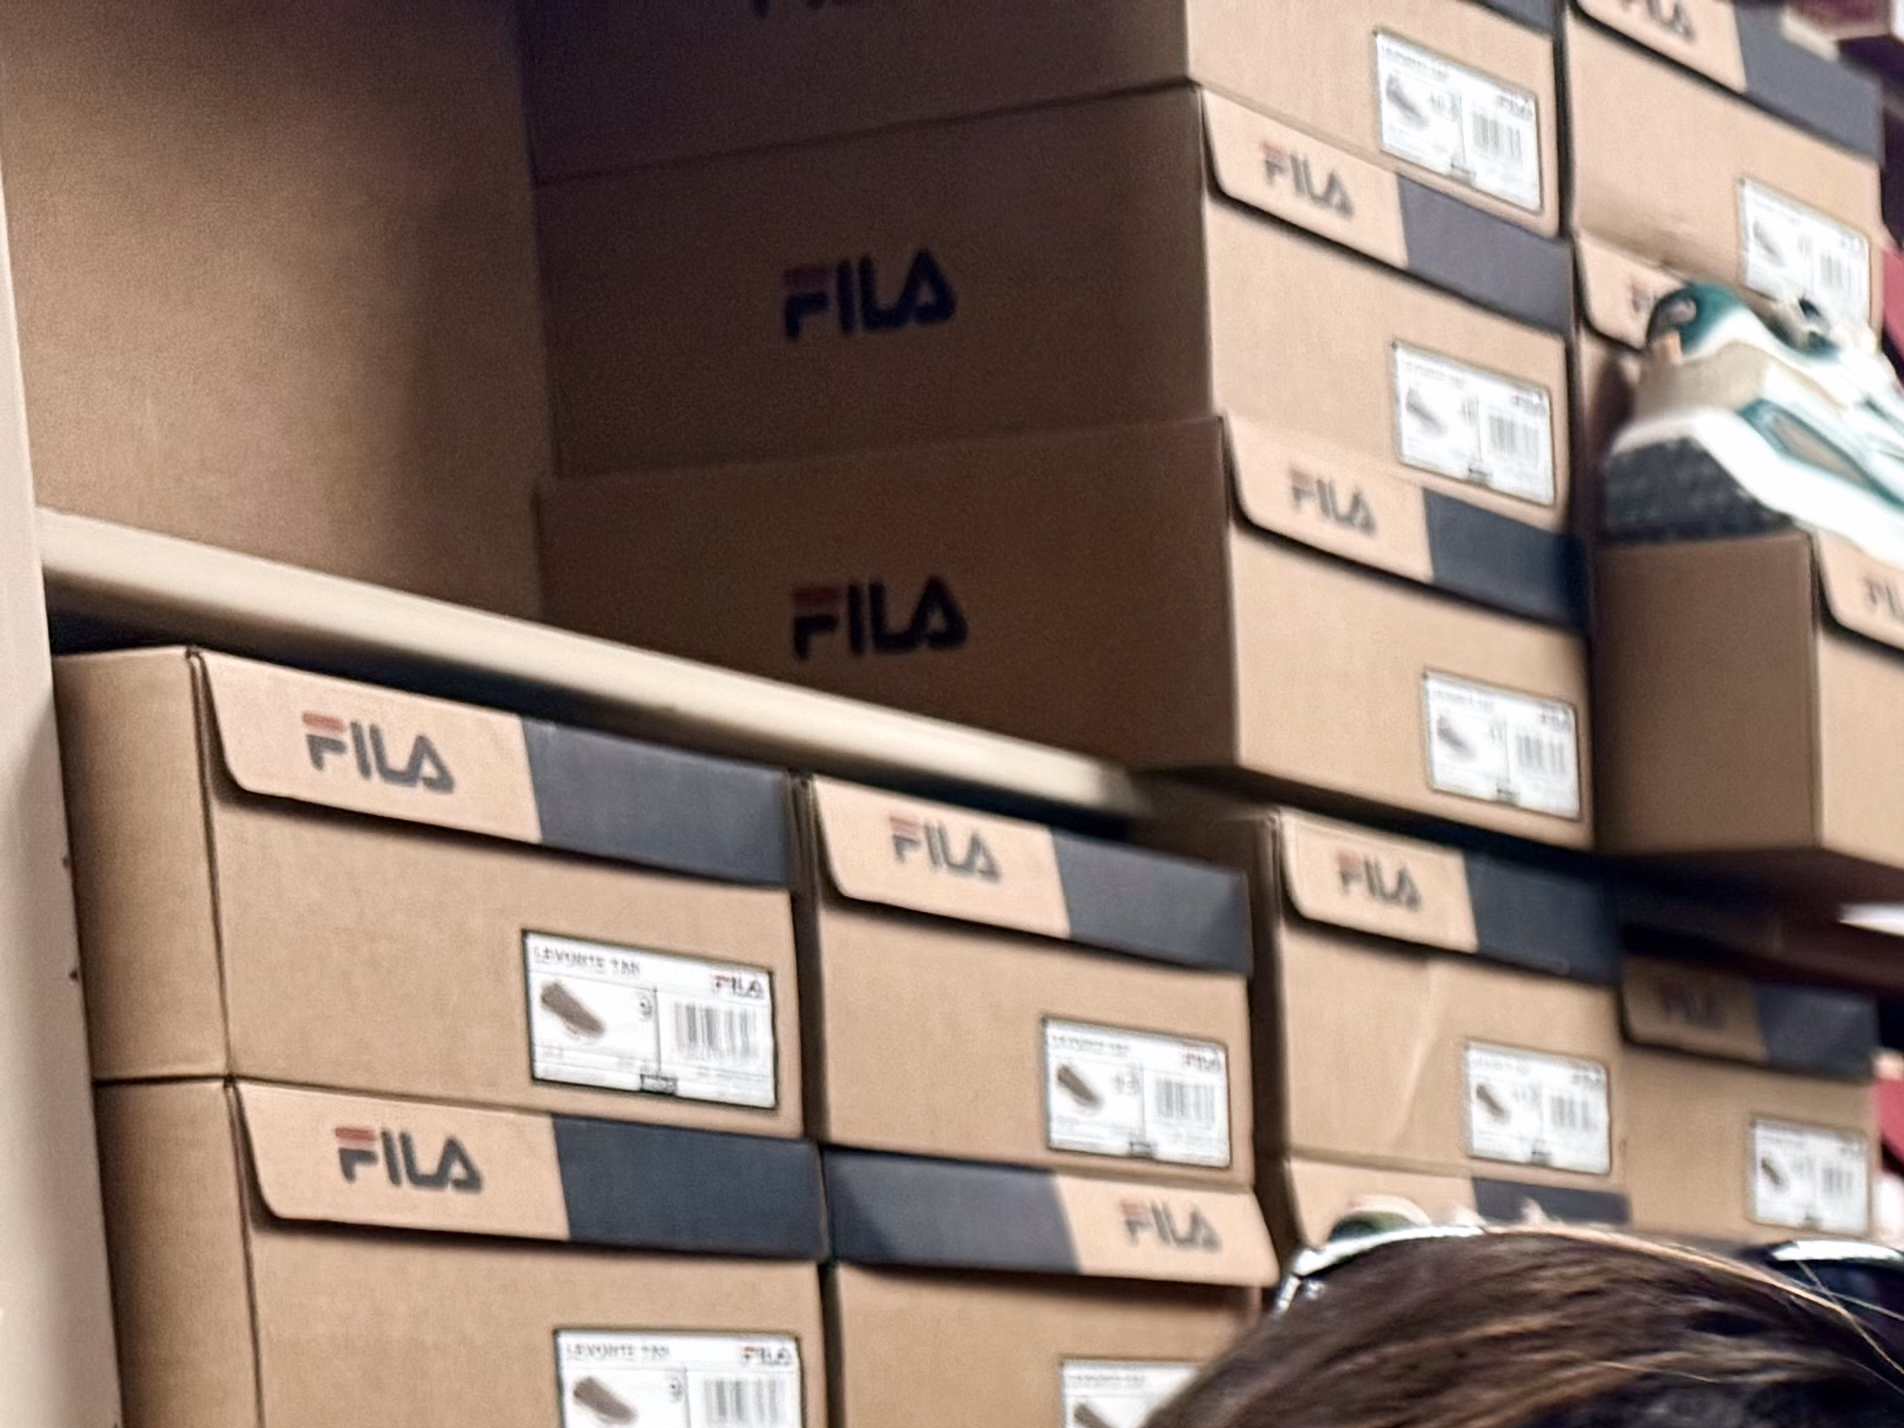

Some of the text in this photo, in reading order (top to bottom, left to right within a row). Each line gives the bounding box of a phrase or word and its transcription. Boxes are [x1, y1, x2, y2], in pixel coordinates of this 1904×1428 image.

[1259, 141, 1355, 217] FILA
[783, 248, 957, 340] FILA
[1287, 468, 1377, 536] FILA
[791, 576, 968, 660] FILA
[302, 711, 455, 794] FILA
[889, 814, 1002, 881] FILA
[1336, 850, 1423, 913] FILA
[712, 971, 764, 1000] FILA
[334, 1126, 484, 1194] FILA
[1123, 1201, 1219, 1252] FILA
[741, 1345, 792, 1367] FILA
